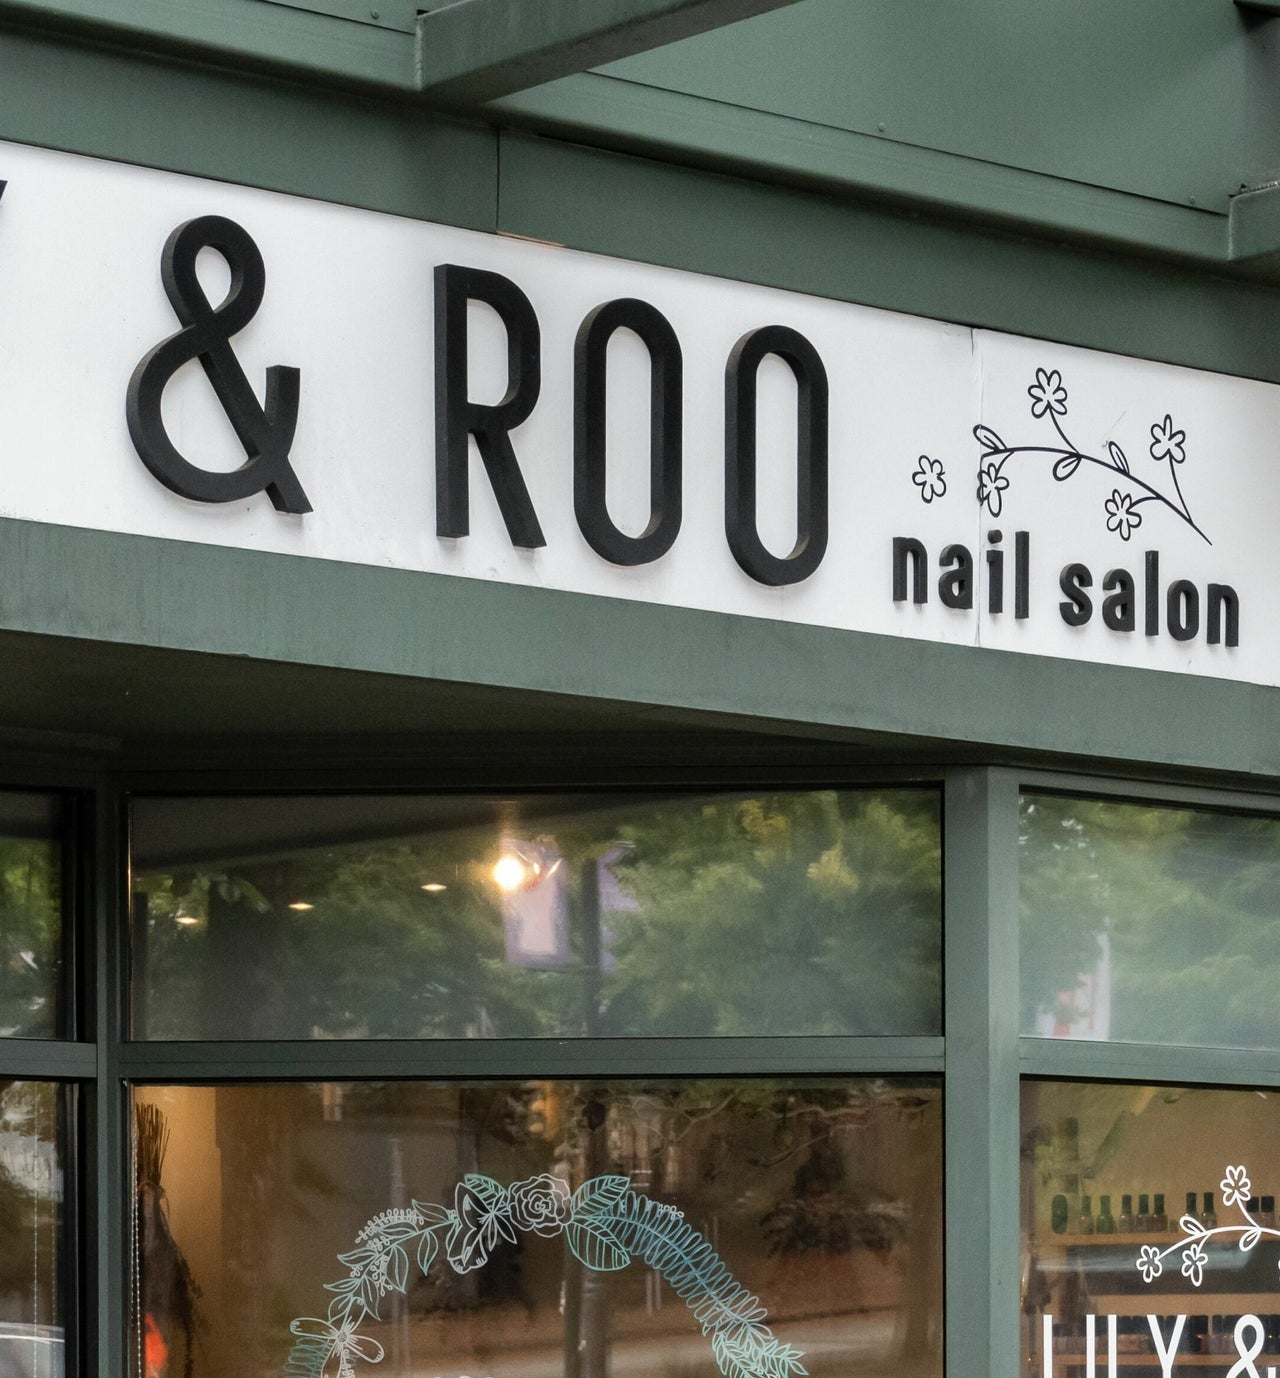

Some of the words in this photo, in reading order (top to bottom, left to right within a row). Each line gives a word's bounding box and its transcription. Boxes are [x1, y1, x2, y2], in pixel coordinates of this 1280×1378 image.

[126, 215, 314, 514] &
[434, 263, 829, 587] ROO
[893, 529, 1029, 619] nail
[1059, 550, 1239, 647] salon
